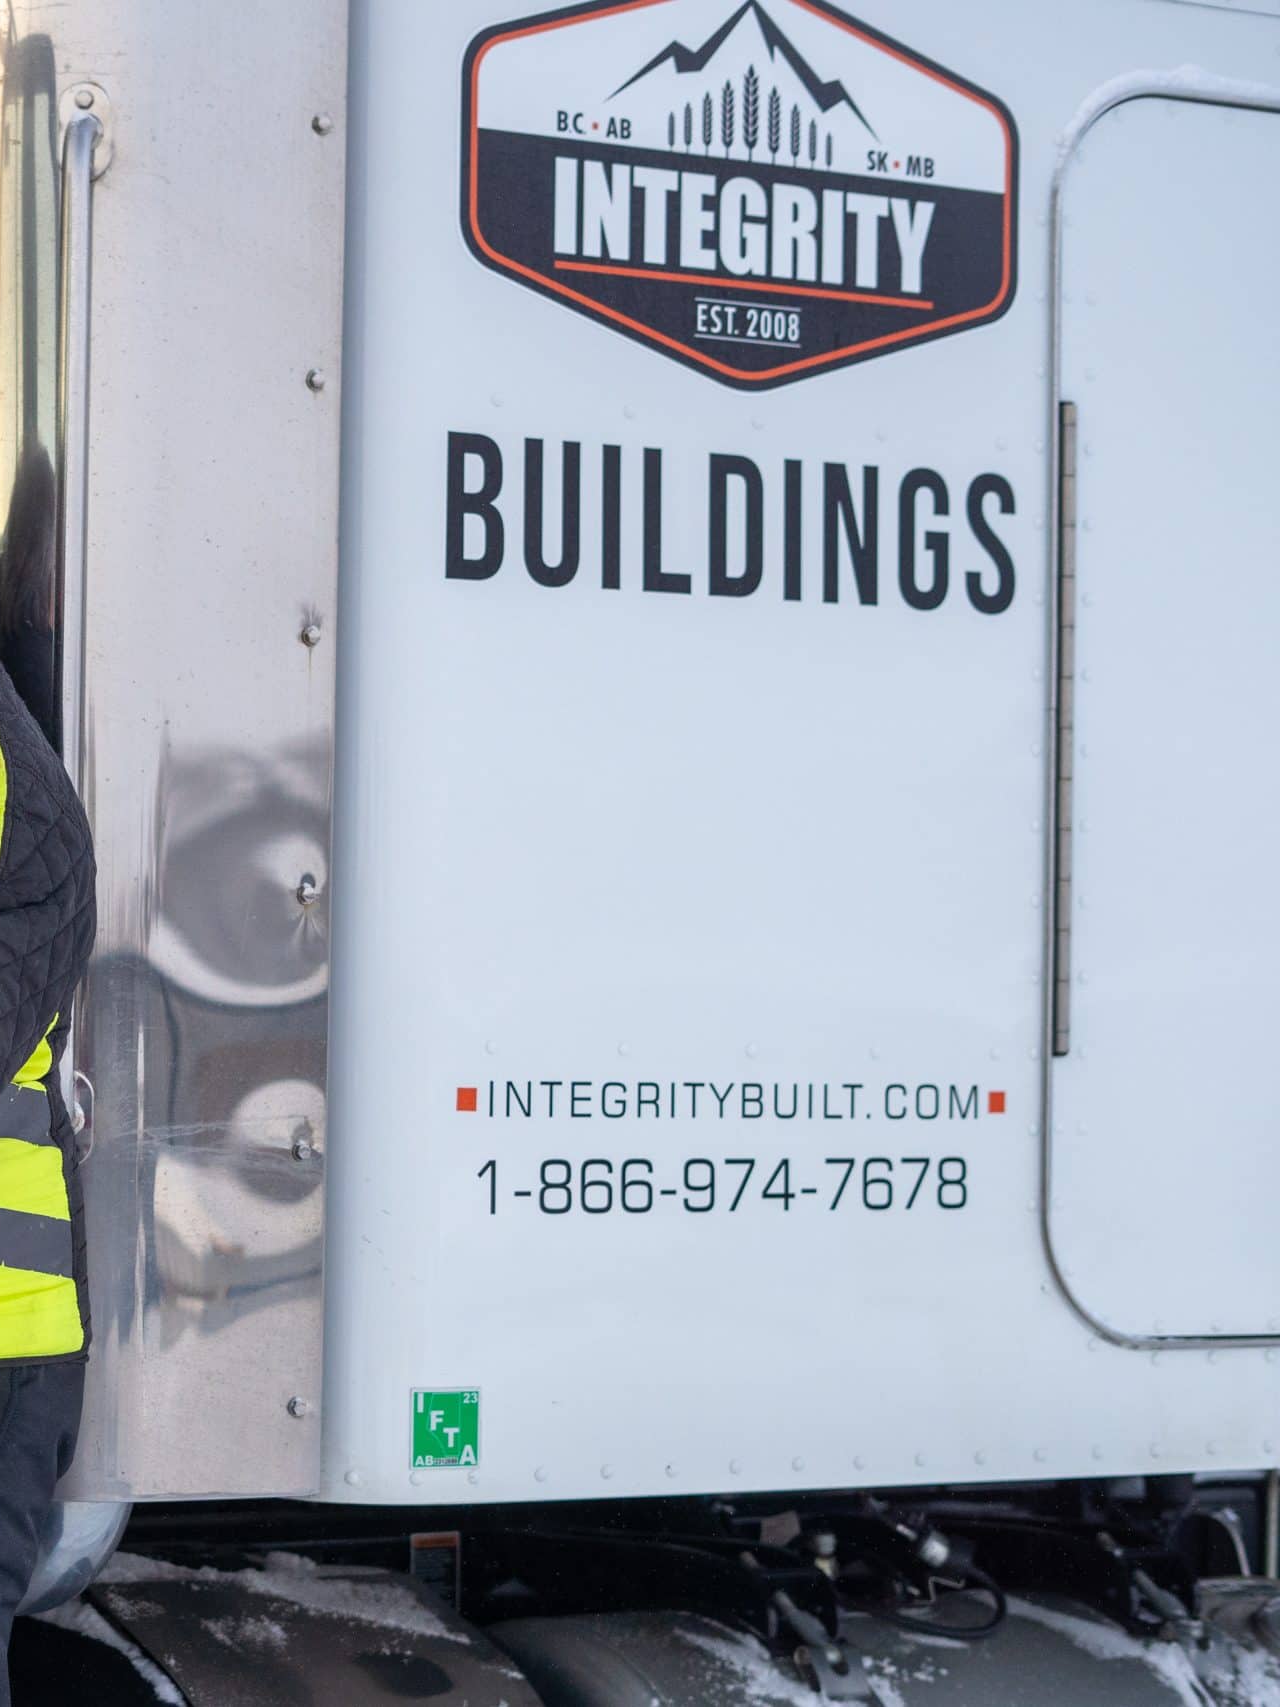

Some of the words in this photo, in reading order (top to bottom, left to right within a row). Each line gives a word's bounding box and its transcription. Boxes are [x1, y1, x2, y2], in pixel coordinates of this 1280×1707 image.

[606, 117, 631, 139] AB
[867, 150, 888, 173] SK
[906, 155, 934, 178] MB
[554, 156, 935, 294] INTEGRITY
[697, 304, 739, 335] EST.
[746, 309, 799, 341] 2008
[445, 431, 1016, 615] BUILDINGS
[488, 1080, 980, 1120] INTEGRITYBUILT.COM
[477, 1156, 968, 1215] 1-866-974-7678
[463, 1393, 478, 1404] 23
[415, 1455, 433, 1466] AB
